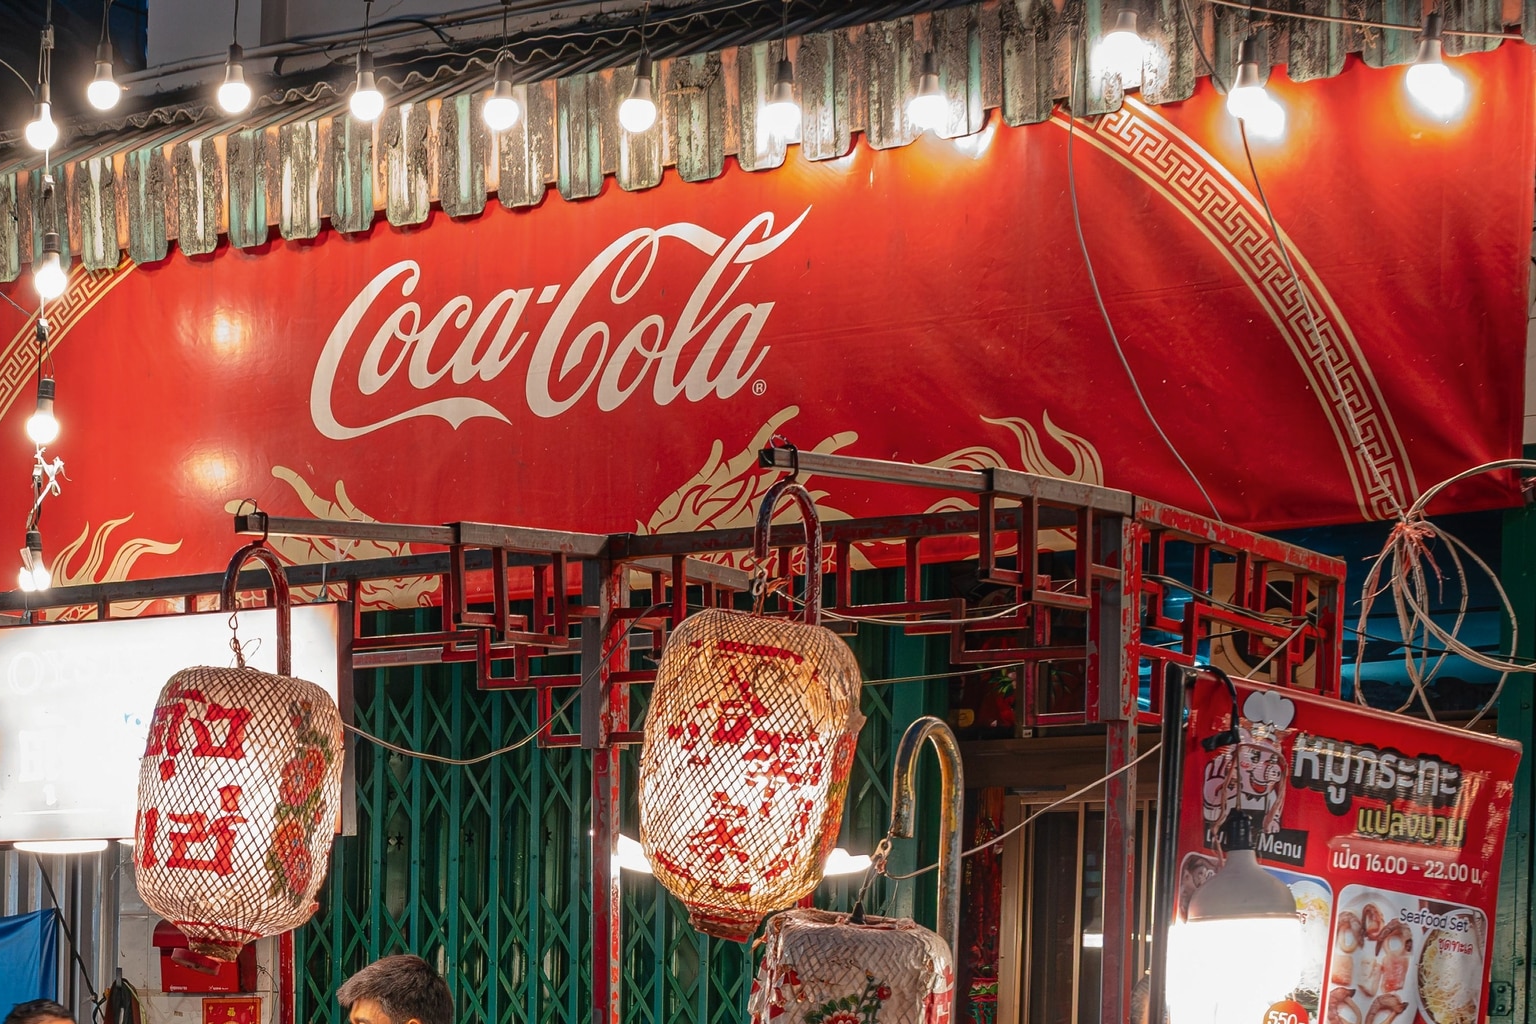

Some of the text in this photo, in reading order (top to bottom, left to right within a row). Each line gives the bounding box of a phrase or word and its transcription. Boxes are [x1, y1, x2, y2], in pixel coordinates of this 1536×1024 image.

[310, 205, 811, 441] Coca-Cola
[1292, 736, 1460, 806] หมูกระทะ
[1257, 832, 1303, 860] Menu
[1333, 843, 1361, 869] เปิด
[1366, 853, 1408, 876] 16.00
[1424, 859, 1469, 883] 22.00
[1400, 908, 1469, 932] Seafood Set
[1438, 938, 1474, 955] ชุดทะเล
